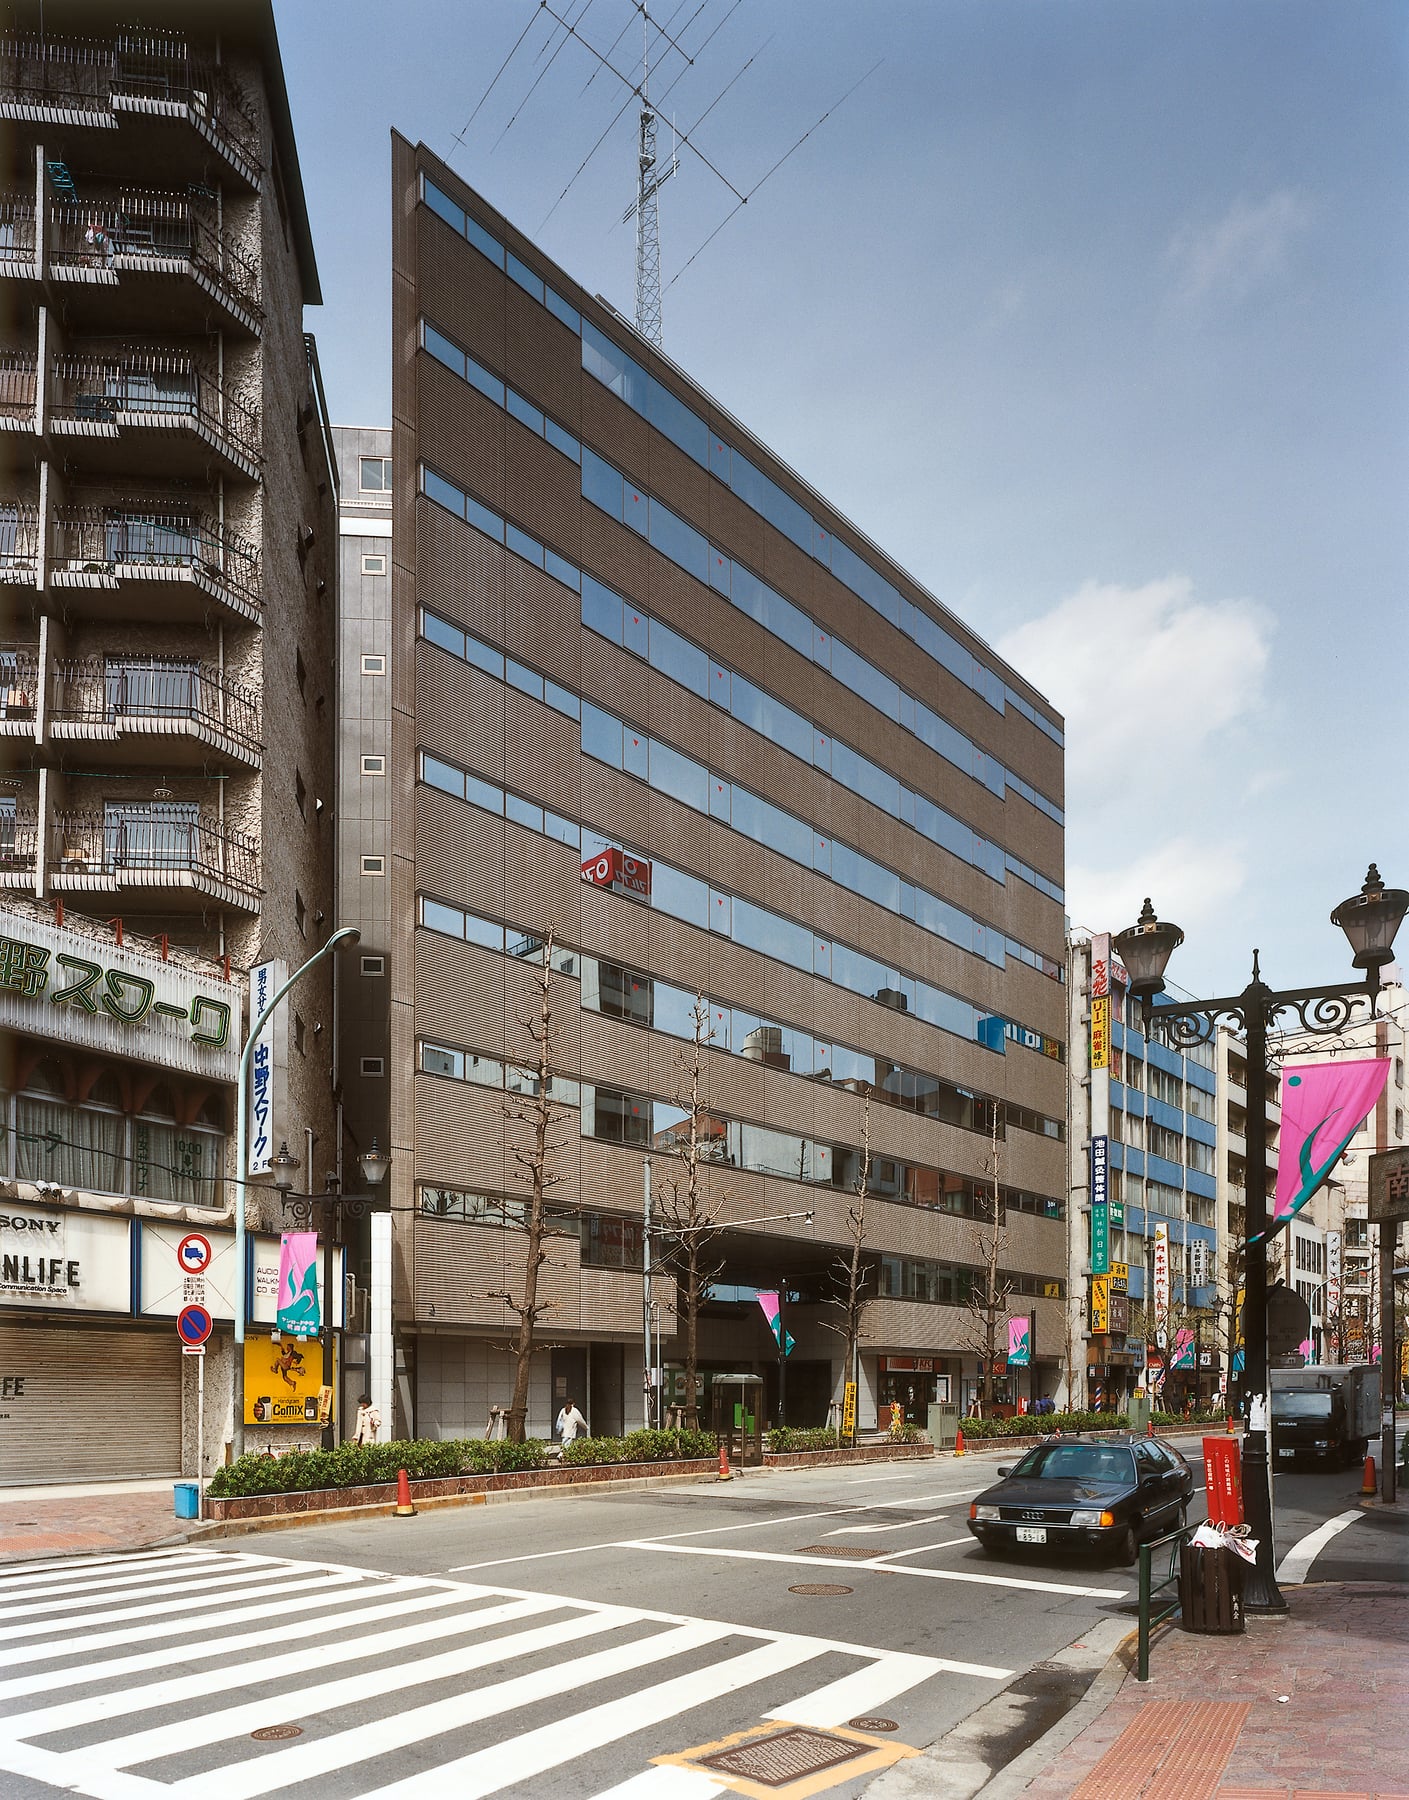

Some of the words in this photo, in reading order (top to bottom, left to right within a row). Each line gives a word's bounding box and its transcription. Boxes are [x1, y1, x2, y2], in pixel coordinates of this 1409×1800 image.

[254, 1043, 269, 1157] 中野スワーク
[0, 1214, 61, 1232] SONY
[256, 1267, 279, 1275] AUDIO
